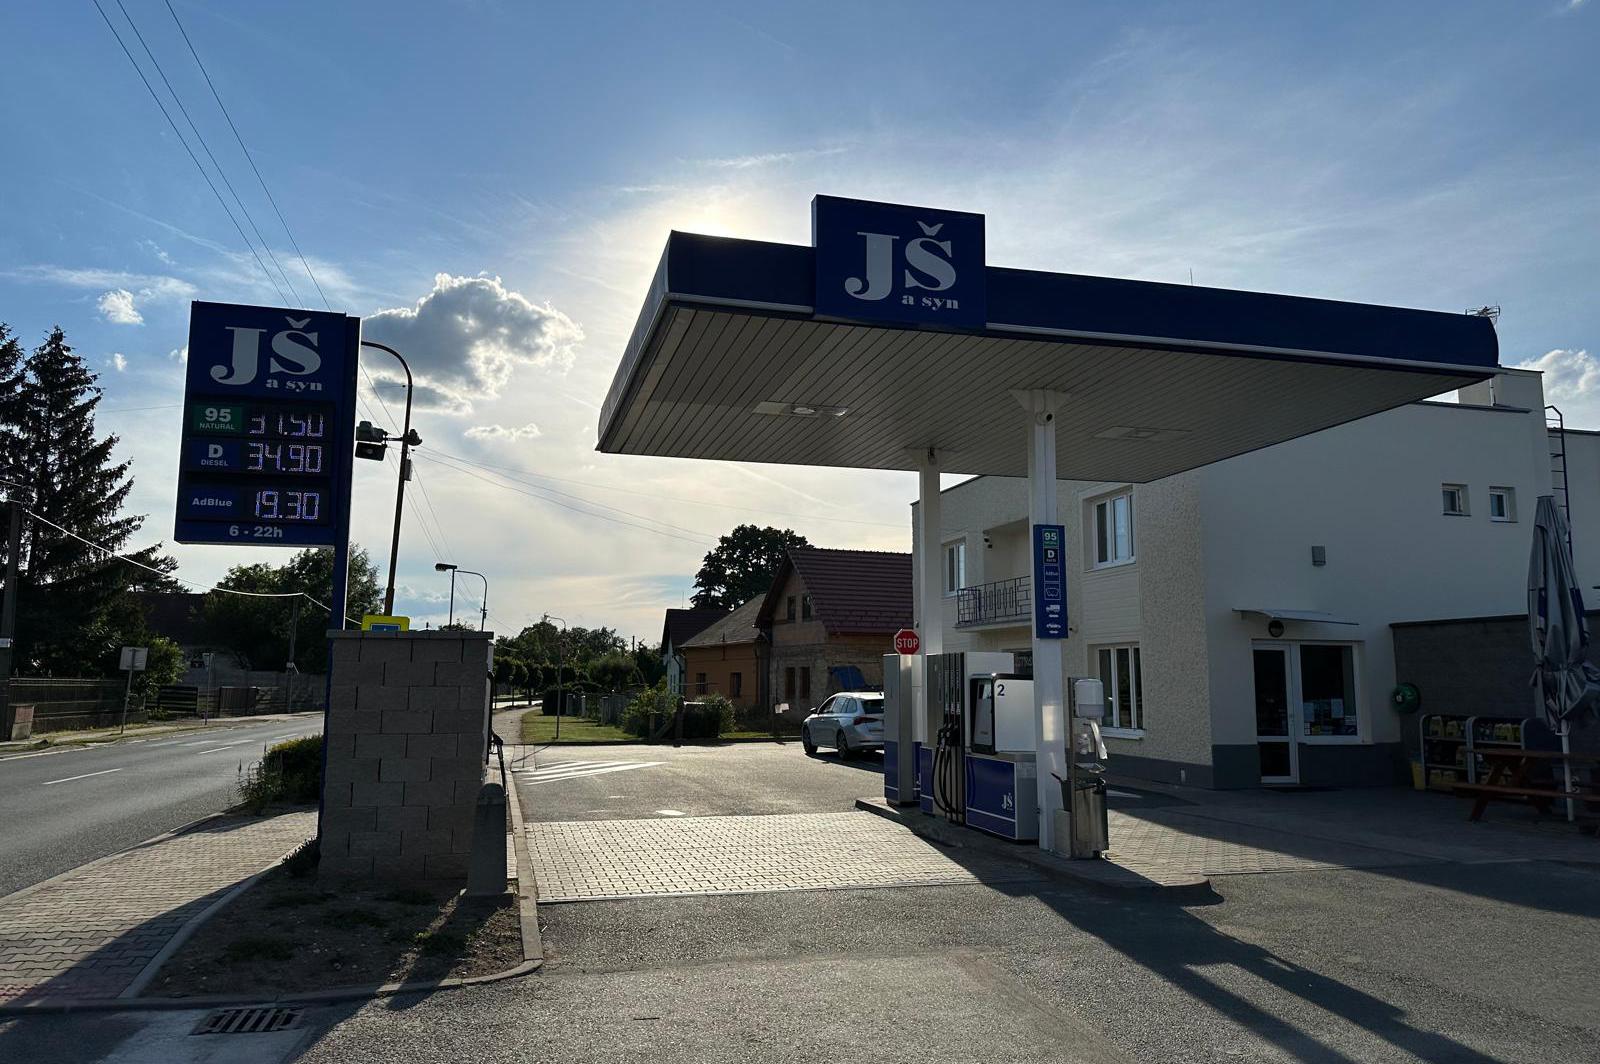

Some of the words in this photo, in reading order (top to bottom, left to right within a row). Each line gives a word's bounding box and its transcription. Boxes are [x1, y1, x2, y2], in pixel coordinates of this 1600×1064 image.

[844, 220, 957, 301] JŠ
[901, 294, 914, 305] a
[921, 296, 959, 311] syn
[210, 316, 322, 386] JŠ
[265, 379, 279, 389] a
[285, 379, 323, 392] syn
[205, 407, 232, 422] 95
[199, 422, 235, 430] NATURAL
[208, 444, 224, 458] D
[247, 442, 322, 473] 34.90
[200, 459, 229, 467] DIESEL
[192, 497, 233, 507] AdBlue
[255, 490, 320, 520] 19.30
[229, 525, 239, 537] 6
[253, 526, 283, 538] 22h
[1044, 532, 1057, 541] 95
[1047, 549, 1055, 559] D
[896, 638, 919, 649] STOP
[996, 683, 1006, 697] 2
